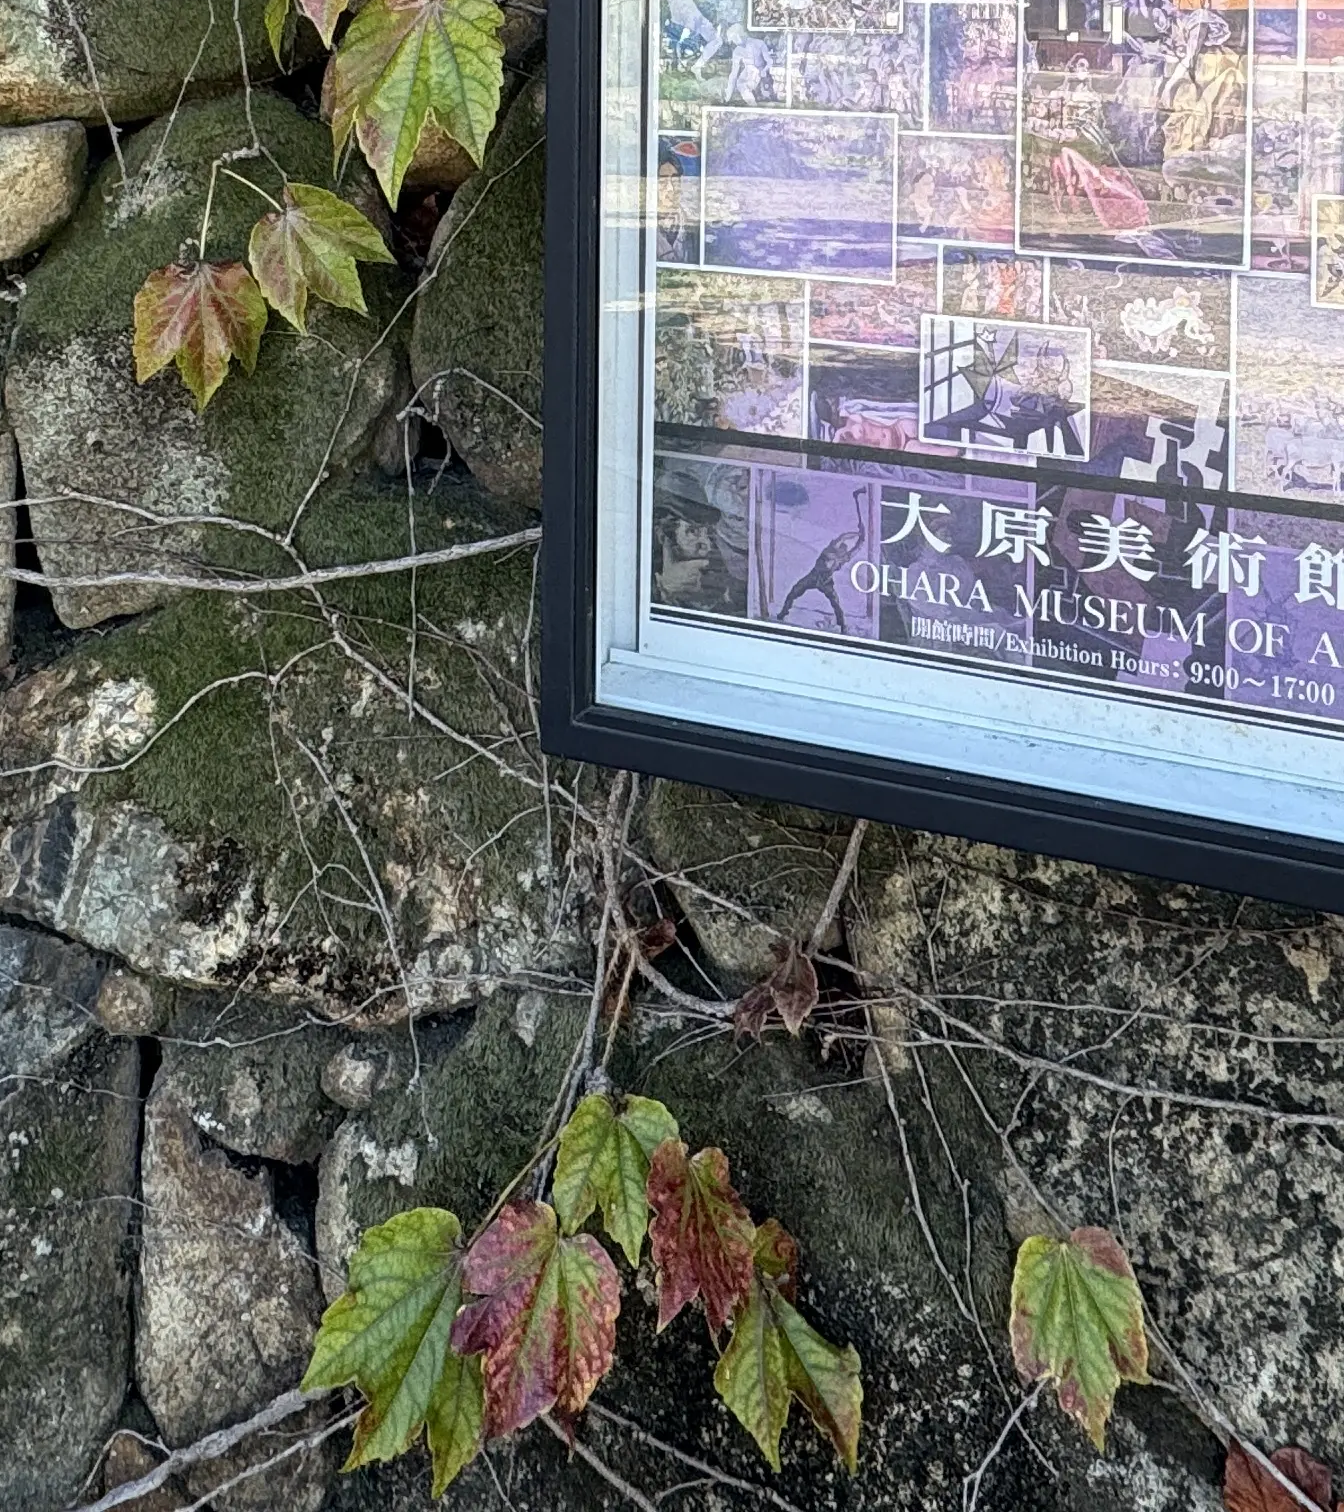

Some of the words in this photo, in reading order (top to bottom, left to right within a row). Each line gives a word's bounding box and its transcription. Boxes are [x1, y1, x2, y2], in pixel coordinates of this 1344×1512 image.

[850, 560, 993, 614] OHARA
[1013, 584, 1206, 648] MUSEUM
[1228, 618, 1291, 658] OF
